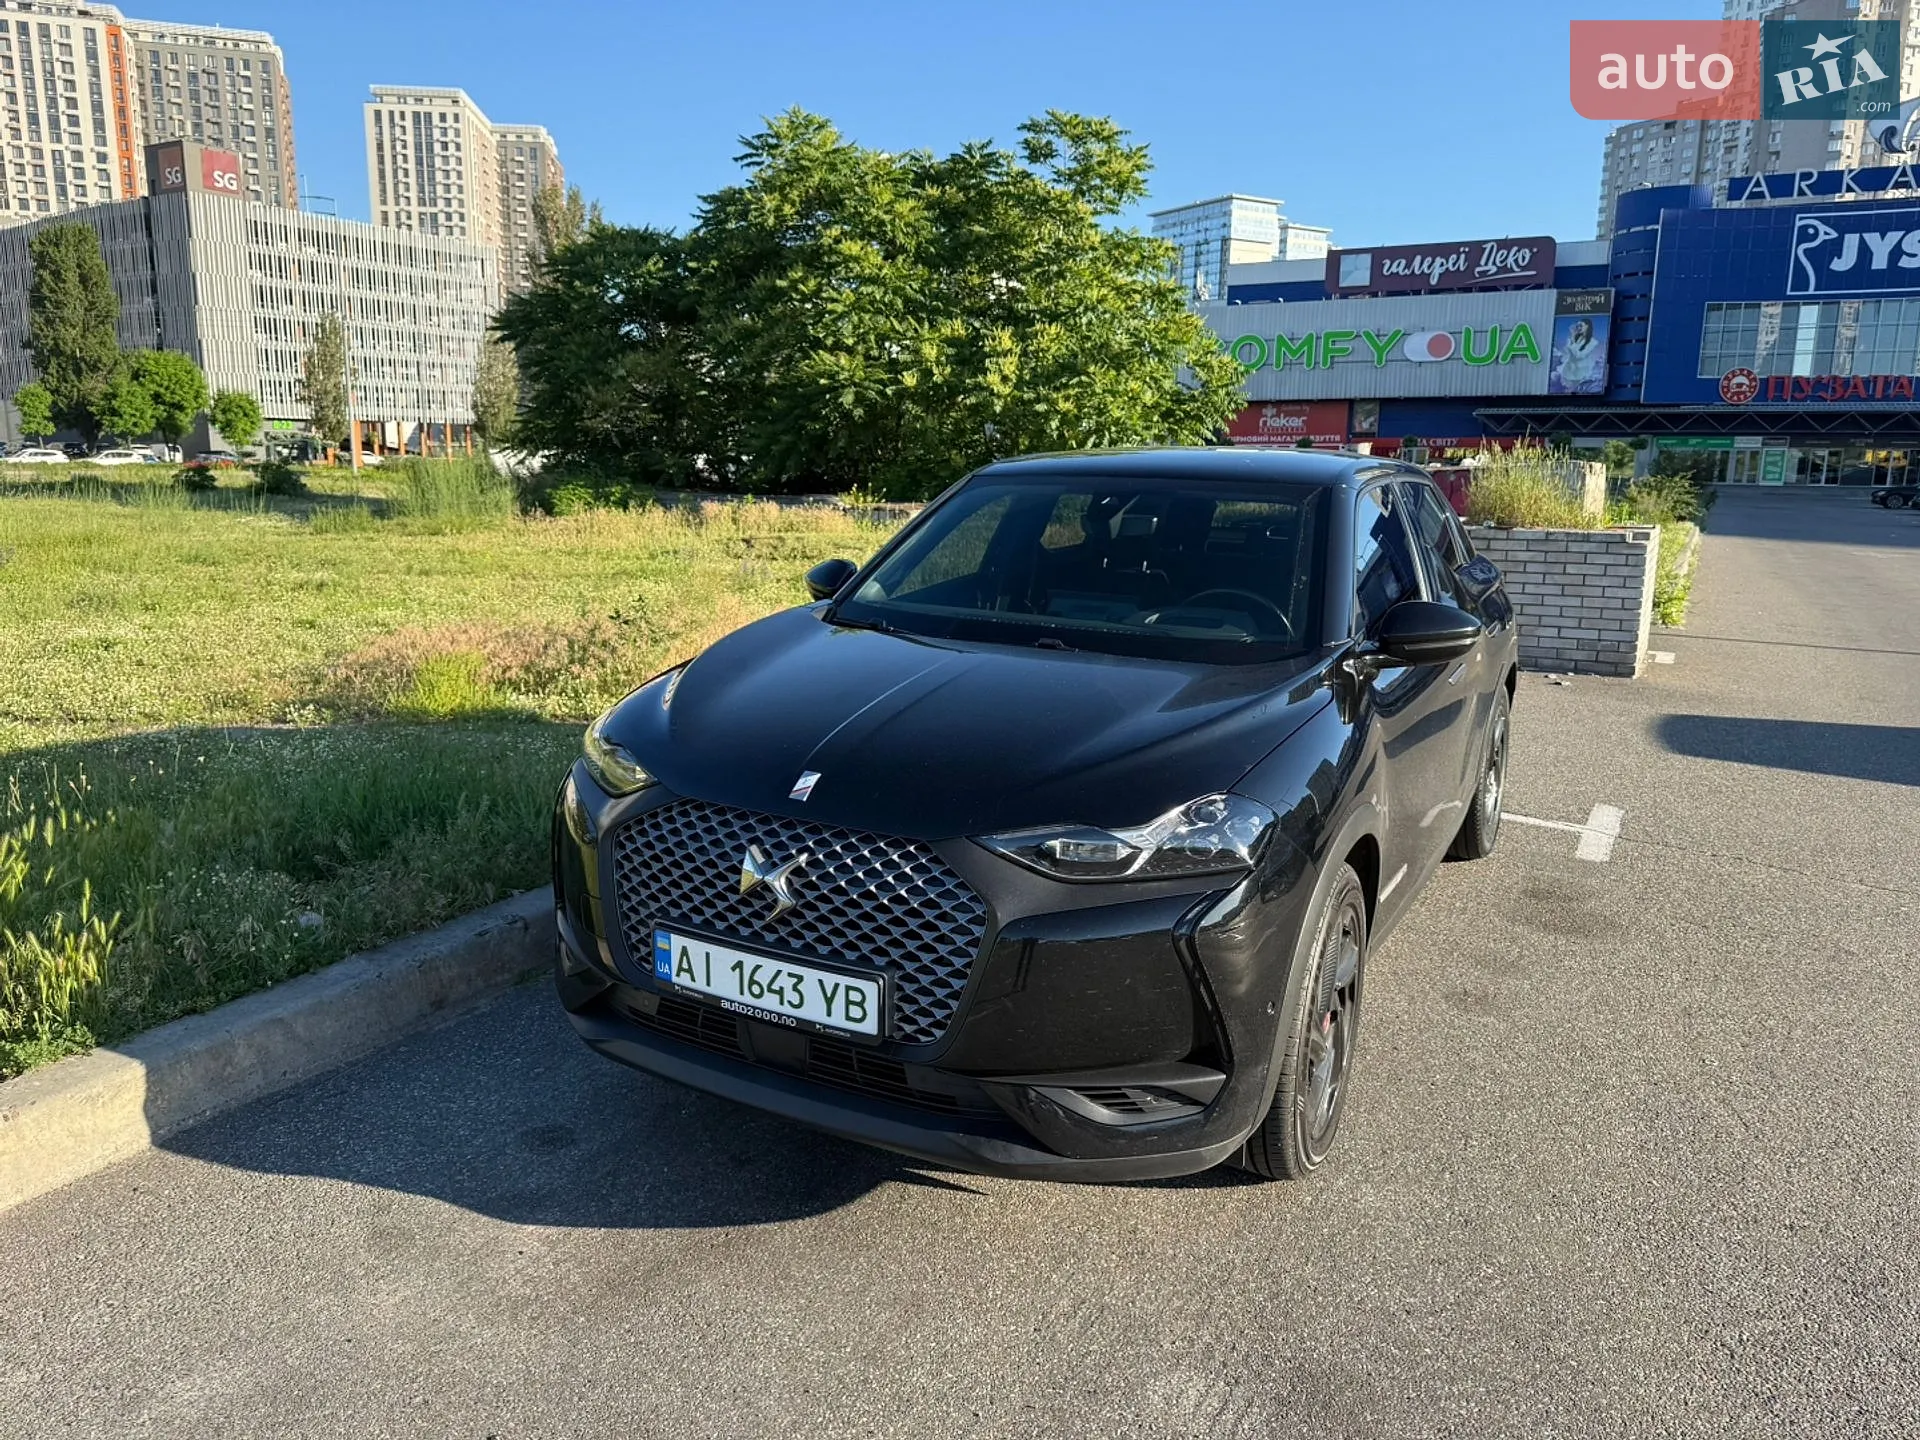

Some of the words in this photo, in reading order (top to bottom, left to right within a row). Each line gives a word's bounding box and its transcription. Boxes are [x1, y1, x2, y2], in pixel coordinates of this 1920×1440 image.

[165, 166, 182, 185] SG
[212, 170, 238, 191] SG
[1382, 247, 1469, 286] галереї
[1474, 241, 1533, 278] Деко
[1216, 328, 1404, 371] OMFY
[1461, 321, 1542, 366] UA
[1766, 374, 1914, 401] ПУЗАТА
[1259, 409, 1308, 428] rieker
[657, 961, 671, 976] UA
[675, 945, 712, 988] AI
[730, 959, 806, 1010] 1643
[817, 978, 868, 1024] YB
[720, 999, 798, 1028] auto2000.no
